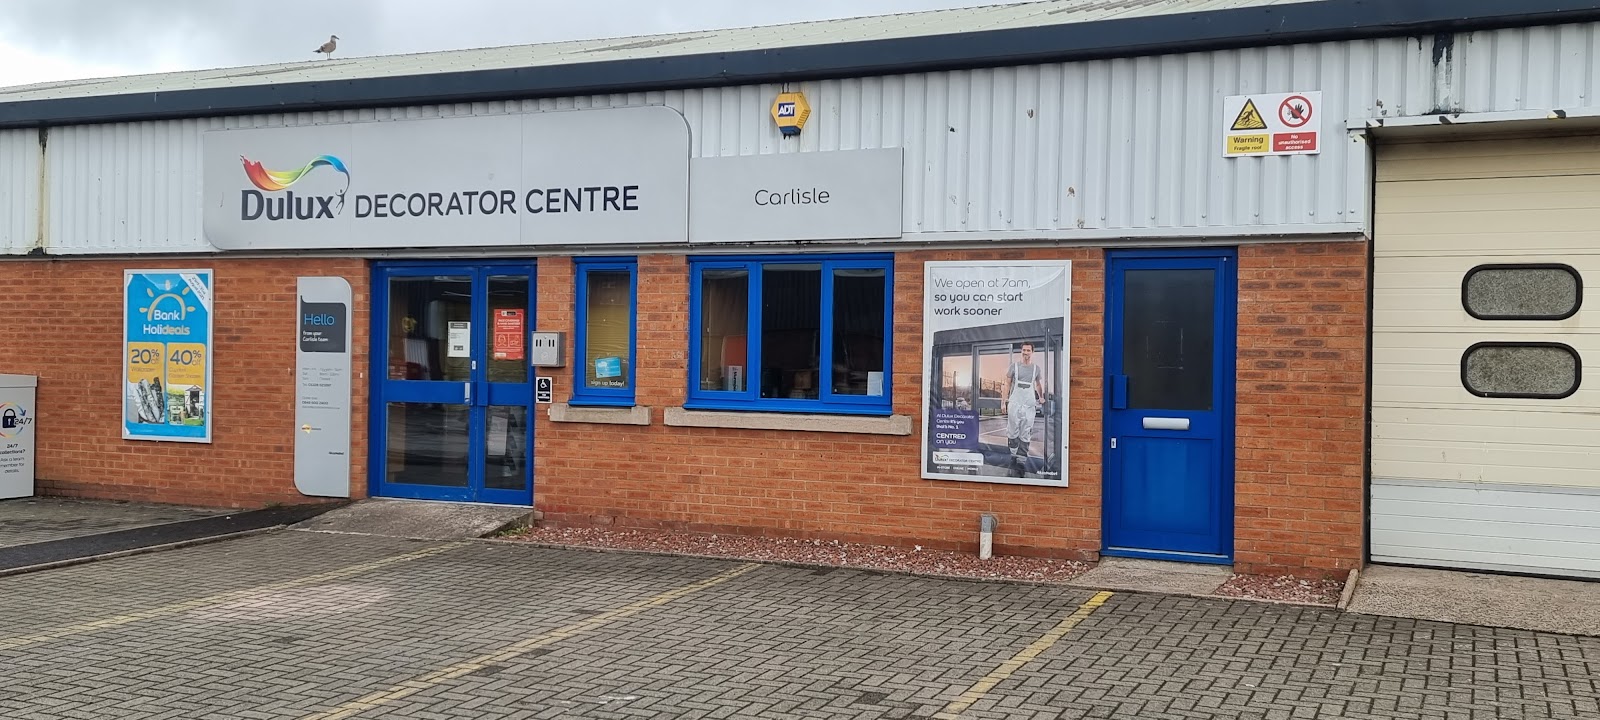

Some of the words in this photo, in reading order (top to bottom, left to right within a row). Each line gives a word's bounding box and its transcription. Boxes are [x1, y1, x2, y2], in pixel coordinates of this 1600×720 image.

[778, 104, 795, 115] ADT
[1233, 136, 1264, 144] Warning
[755, 187, 830, 206] Carlisle
[241, 189, 335, 221] Dulux
[355, 190, 517, 218] DECORATOR
[526, 185, 639, 214] CENTRE
[934, 278, 953, 288] We
[955, 279, 985, 289] open
[987, 278, 999, 288] at
[1001, 278, 1031, 288] 7am,
[949, 294, 970, 303] you
[996, 292, 1023, 302] start
[154, 310, 180, 321] Bank
[934, 306, 961, 315] work
[963, 308, 1003, 316] sooner
[304, 313, 335, 325] Hello
[143, 324, 191, 335] Holideals
[131, 349, 160, 364] 20%
[170, 349, 202, 366] 40%
[14, 417, 32, 425] 24/7
[936, 432, 967, 440] CENTRED
